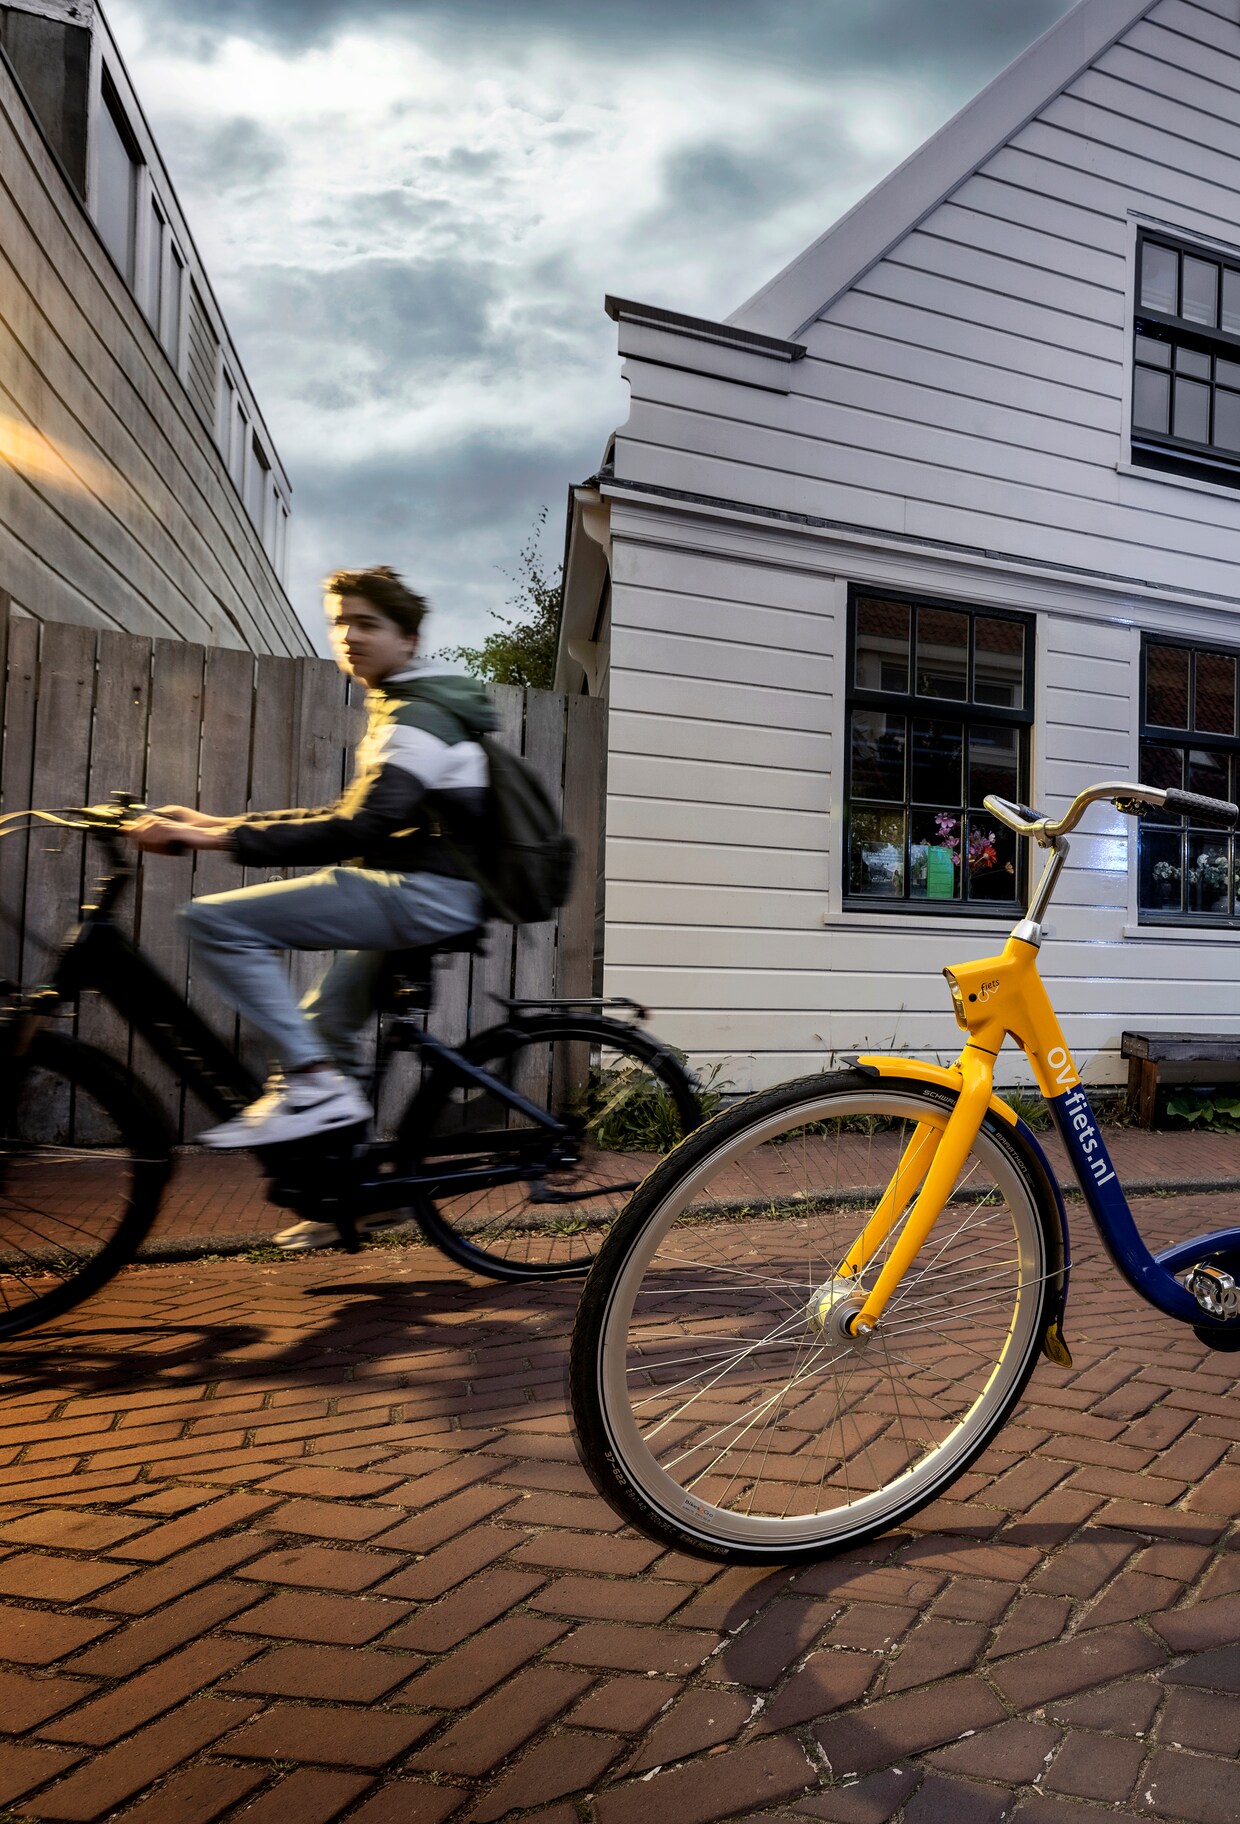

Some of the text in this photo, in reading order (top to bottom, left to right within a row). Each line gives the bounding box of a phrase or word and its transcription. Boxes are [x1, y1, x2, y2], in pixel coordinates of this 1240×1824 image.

[980, 979, 1000, 997] fiets
[1046, 1046, 1116, 1187] OV-fiets.nl
[995, 1132, 1028, 1173] MARATHON
[604, 1450, 627, 1486] 37-622
